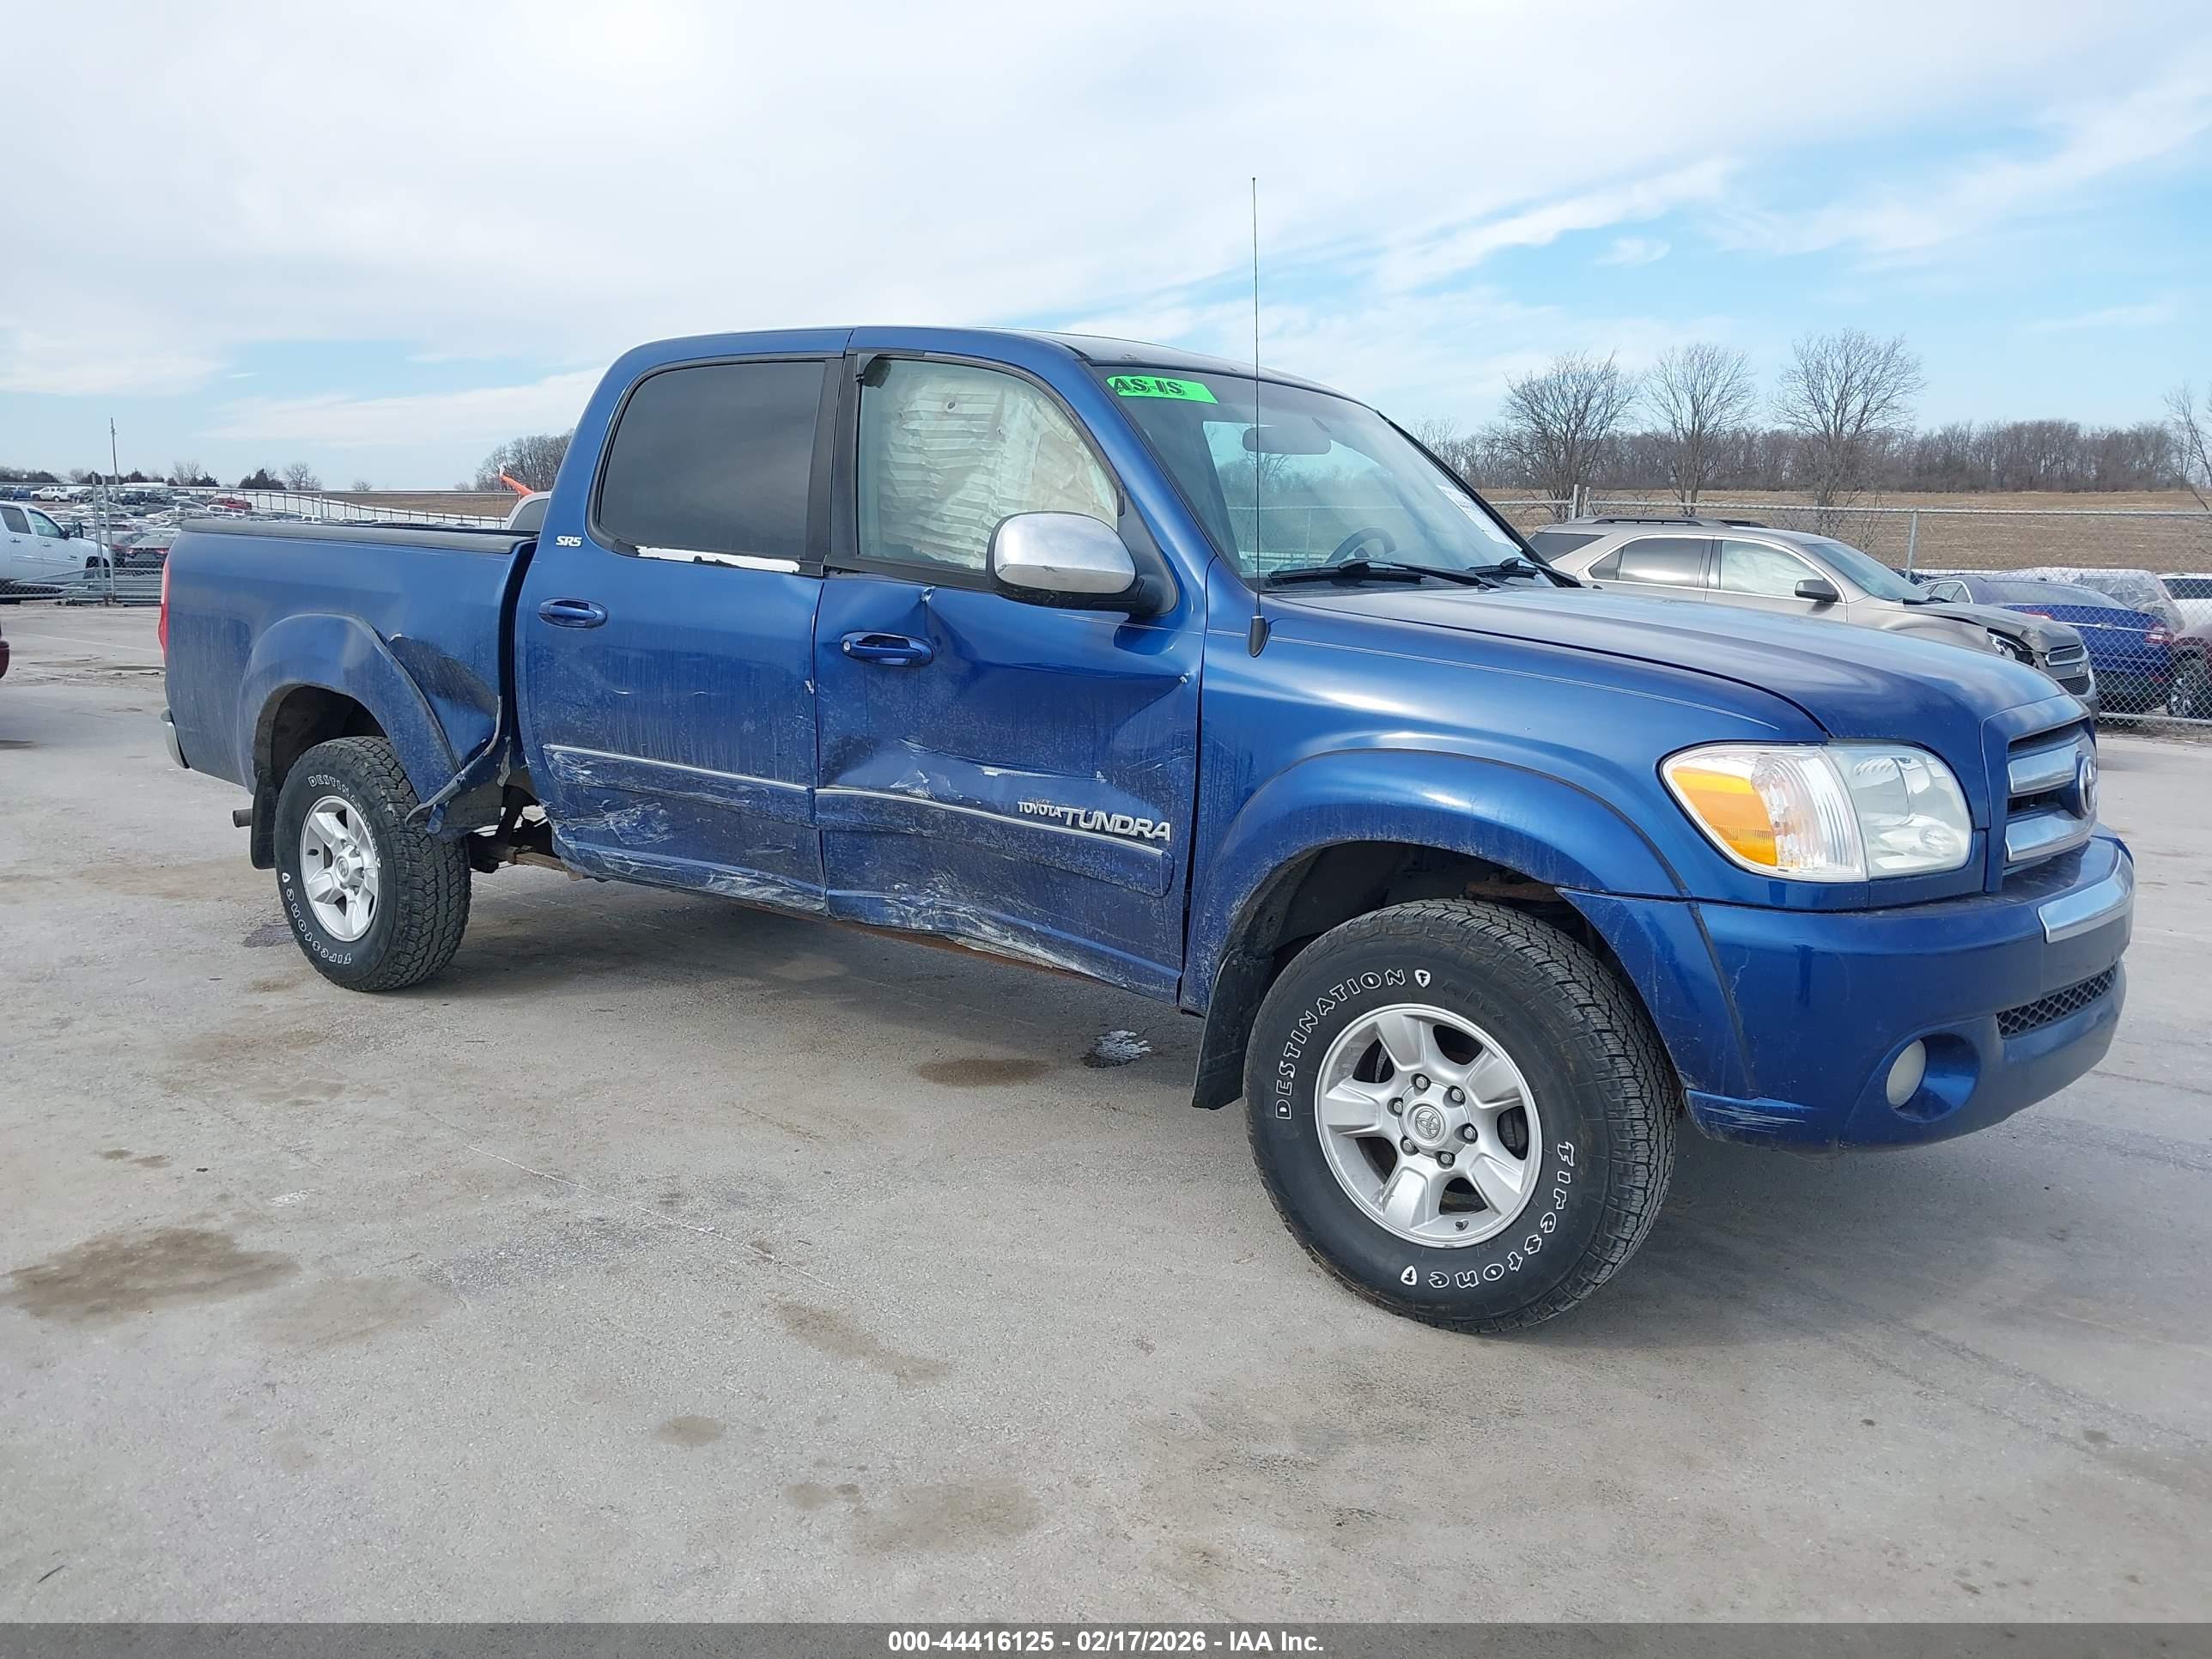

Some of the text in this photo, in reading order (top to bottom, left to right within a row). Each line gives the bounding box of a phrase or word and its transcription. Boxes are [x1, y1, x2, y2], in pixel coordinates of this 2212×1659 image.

[1113, 378, 1185, 395] AS-IS
[556, 535, 582, 547] SR5
[1017, 800, 1171, 842] TOYOTA TUNDRA
[1275, 968, 1407, 1120] DESTINATION
[1428, 1141, 1575, 1289] Firestone
